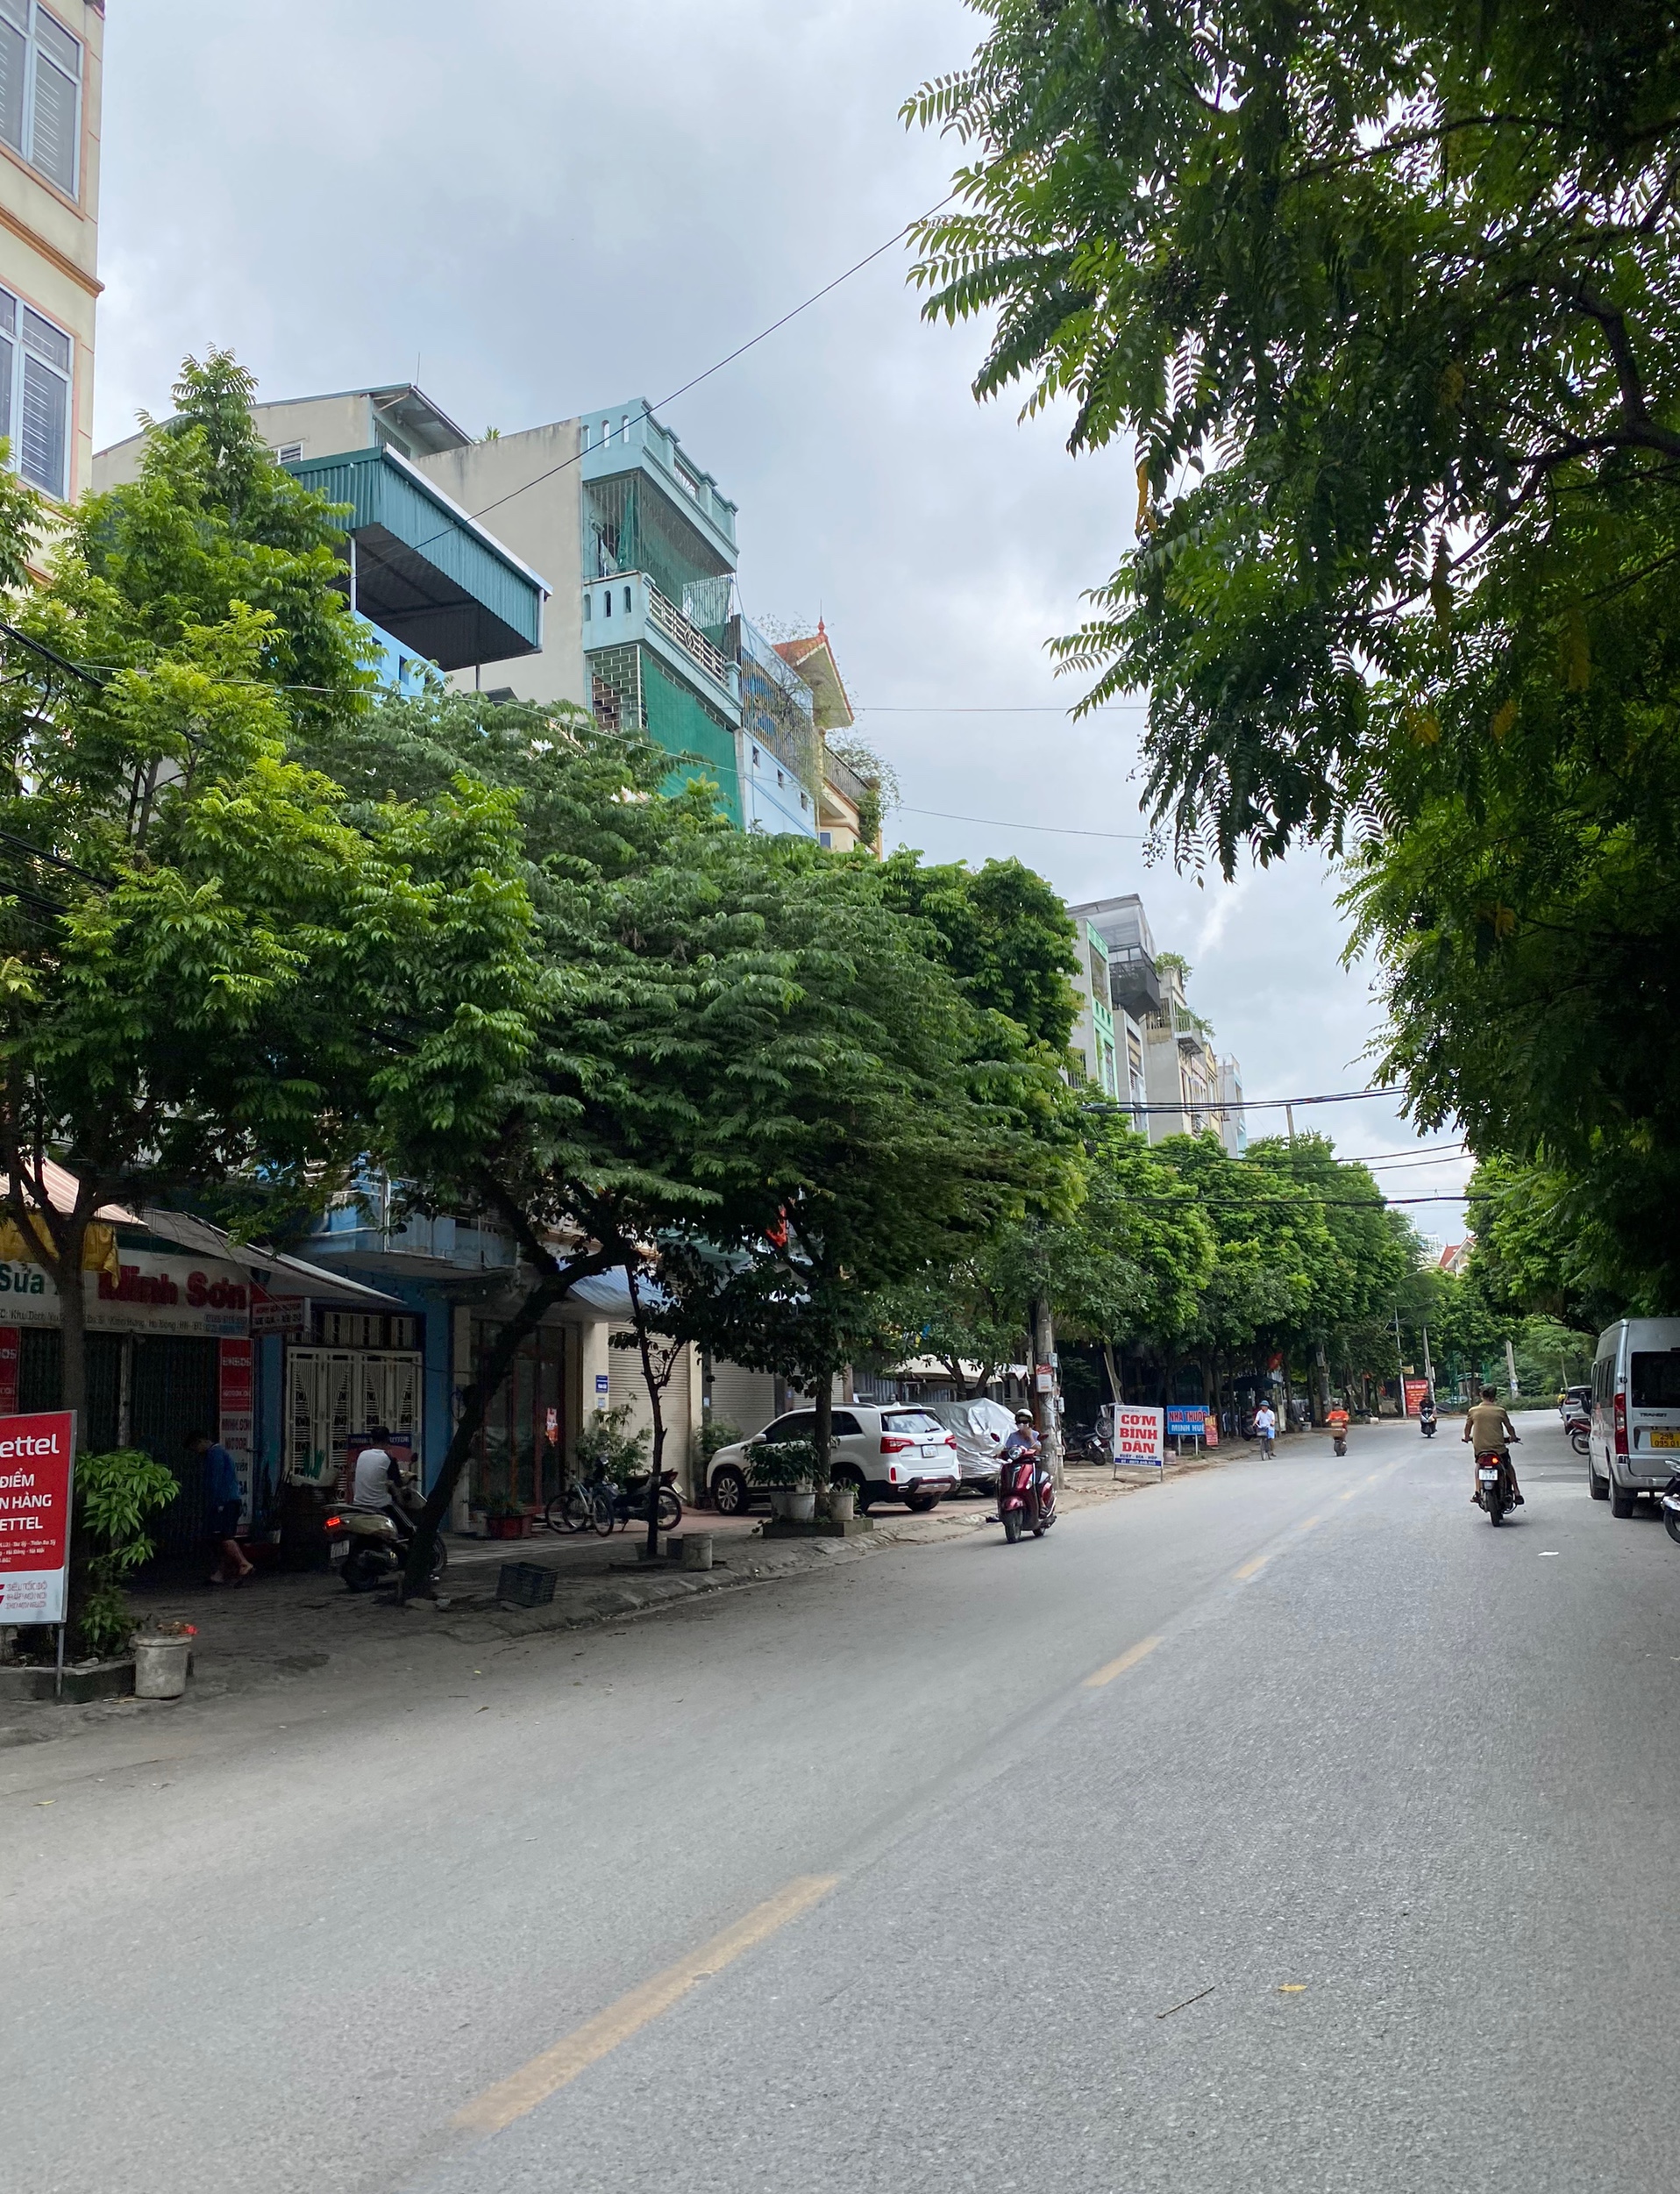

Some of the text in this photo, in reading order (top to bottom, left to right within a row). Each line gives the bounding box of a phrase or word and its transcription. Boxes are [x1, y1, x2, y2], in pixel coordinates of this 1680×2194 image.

[0, 1263, 44, 1294] Sửa
[98, 1265, 246, 1310] Minh Sơn
[1121, 1414, 1157, 1426] CƠM
[1169, 1408, 1183, 1421] NHÀ
[1120, 1427, 1157, 1440] BÌNH
[0, 1434, 60, 1457] ettel
[1122, 1441, 1155, 1454] DÂN
[0, 1468, 35, 1488] ĐIỂM
[12, 1492, 52, 1509] HÀNG
[0, 1516, 43, 1532] ETTEL
